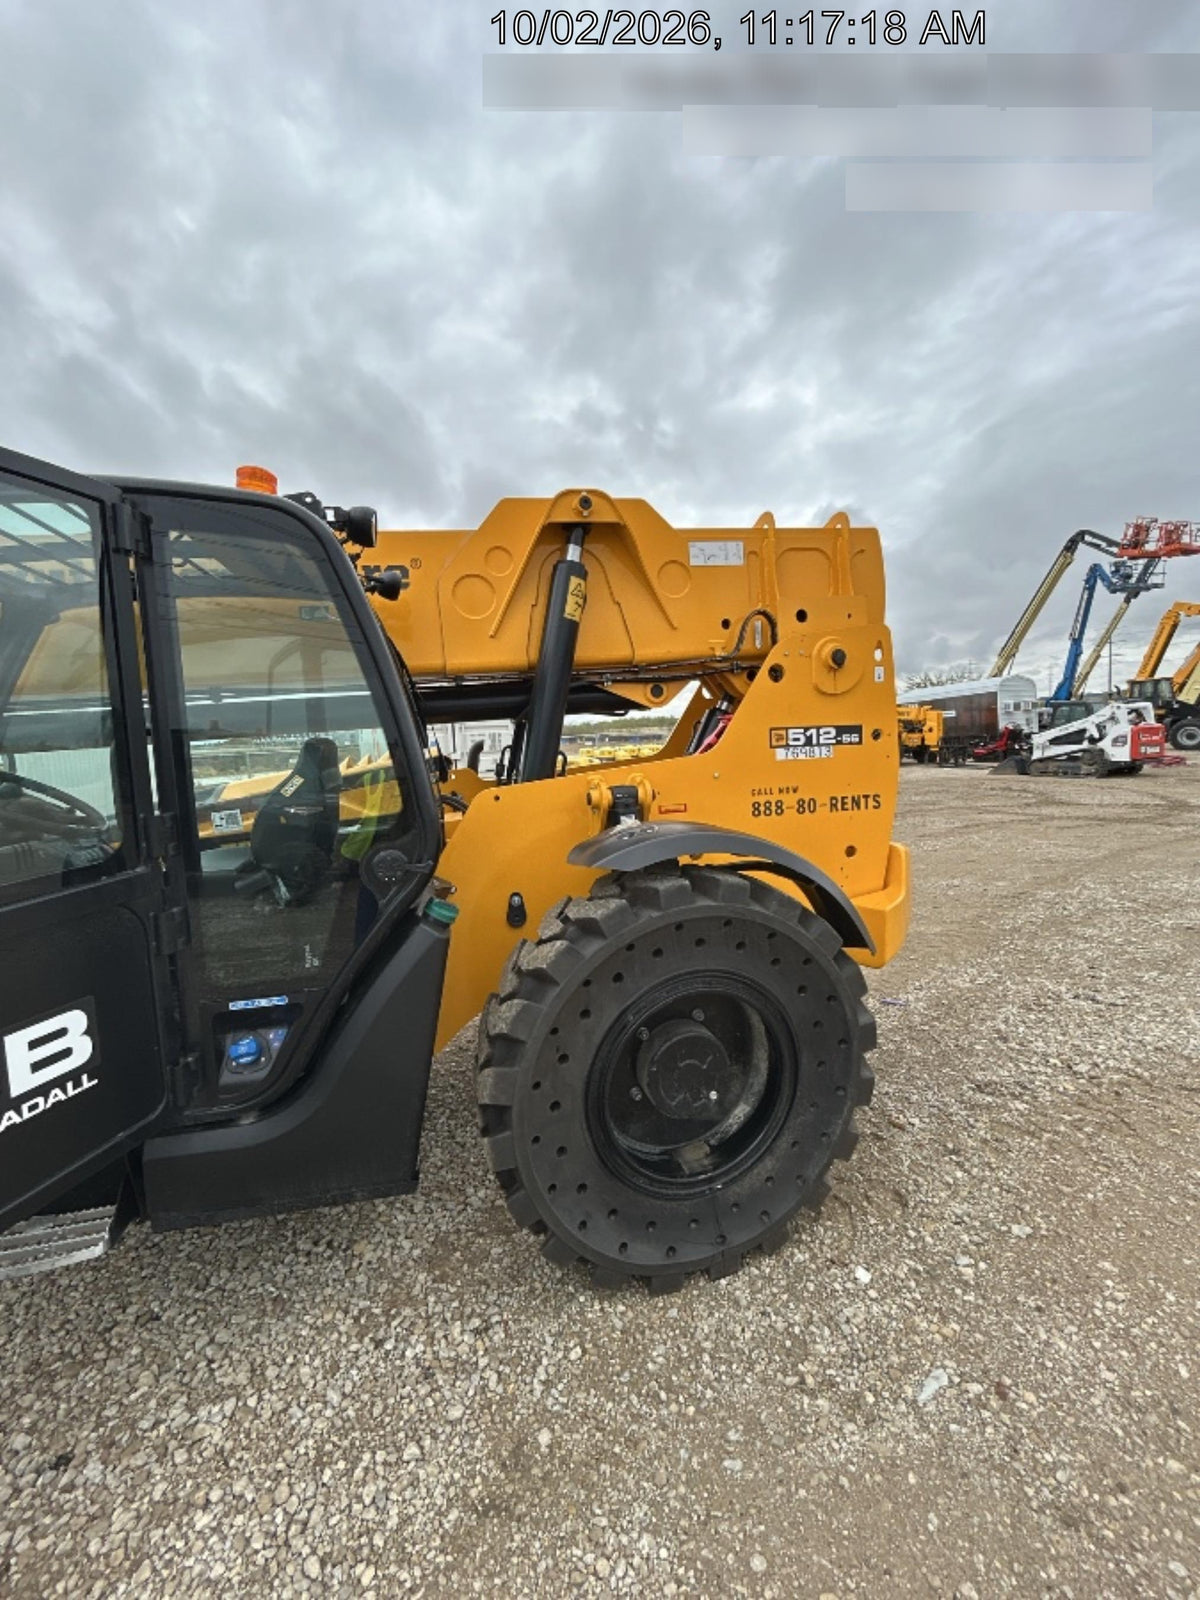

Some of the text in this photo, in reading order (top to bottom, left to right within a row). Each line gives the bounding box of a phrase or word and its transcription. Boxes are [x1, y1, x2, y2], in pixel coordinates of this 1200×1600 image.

[751, 786, 799, 797] CALL NOW
[751, 794, 881, 817] 888-80-RENTS
[3, 1009, 93, 1098] B
